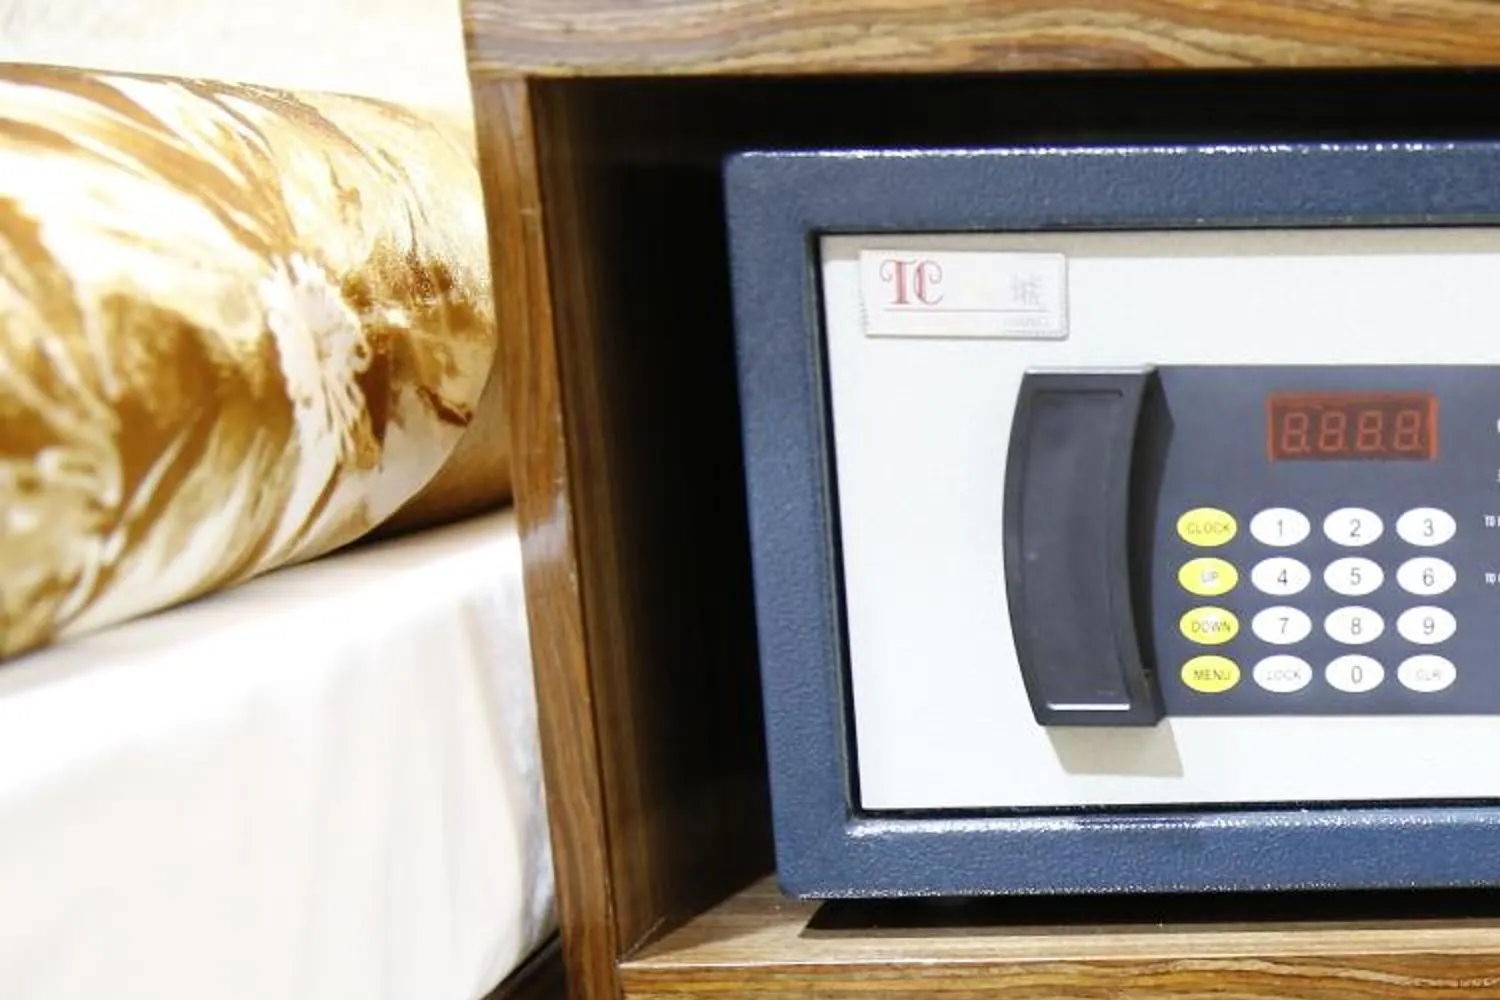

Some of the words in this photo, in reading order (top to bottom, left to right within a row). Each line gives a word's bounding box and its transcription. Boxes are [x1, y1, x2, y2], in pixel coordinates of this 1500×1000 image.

[1186, 521, 1231, 535] CLOCK
[1276, 519, 1285, 537] 1
[1349, 519, 1362, 538] 2
[1422, 518, 1434, 538] 3
[1200, 570, 1219, 583] UP
[1277, 568, 1288, 586] 4
[1350, 567, 1361, 586] 5
[1422, 567, 1435, 586] 6
[1190, 619, 1232, 634] DOWN
[1278, 617, 1289, 635] 7
[1350, 617, 1362, 635] 8
[1423, 616, 1435, 635] 9
[1193, 668, 1232, 682] MENU
[1266, 668, 1302, 682] LOCK
[1351, 665, 1363, 684] 0
